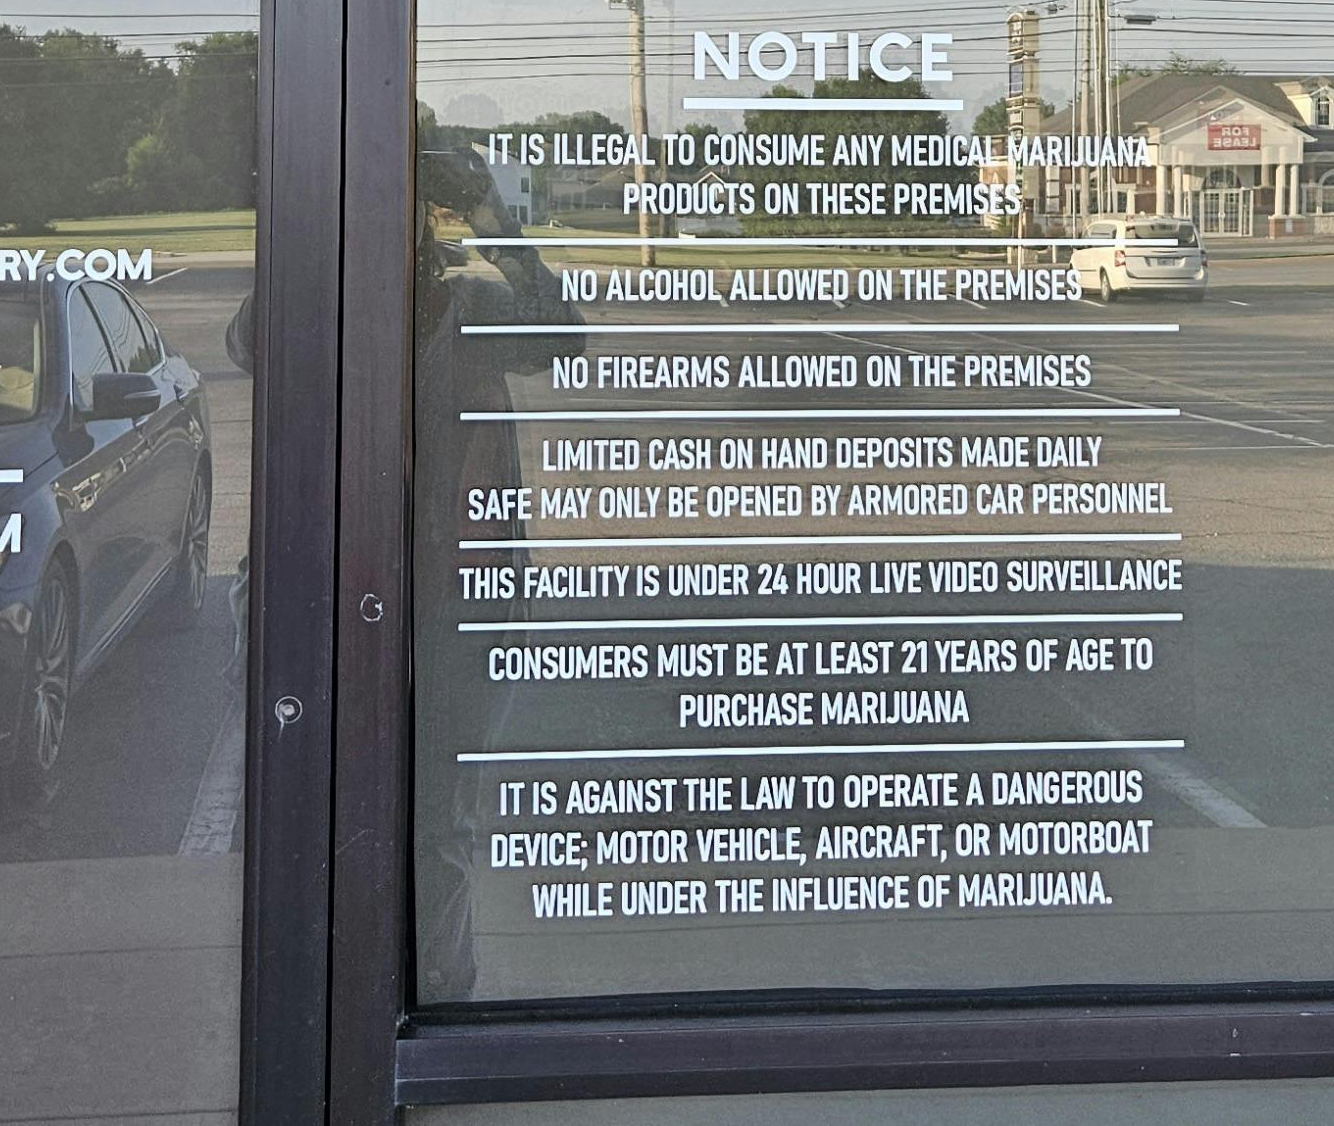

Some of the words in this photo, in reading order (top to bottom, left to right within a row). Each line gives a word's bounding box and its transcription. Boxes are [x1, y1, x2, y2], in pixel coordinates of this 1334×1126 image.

[694, 32, 954, 82] NOTICE
[488, 133, 515, 164] IT
[519, 133, 546, 165] IS
[553, 134, 655, 165] ILLEGAL
[659, 135, 696, 165] TO
[705, 134, 825, 165] CONSUME
[833, 135, 885, 166] ANY
[891, 135, 999, 166] MEDICAL
[1008, 136, 1151, 166] MARIJUANA
[623, 183, 755, 215] PRODUCTS
[764, 183, 799, 215] ON
[806, 183, 886, 215] THESE
[895, 183, 1021, 215] PREMISES
[561, 270, 599, 302] NO
[606, 270, 721, 302] ALCOHOL
[731, 270, 850, 301] ALLOWED
[858, 270, 895, 301] ON
[901, 270, 948, 300] THE
[956, 269, 1082, 300] PREMISES
[553, 356, 589, 389] NO
[598, 356, 729, 388] FIREARMS
[738, 356, 857, 388] ALLOWED
[867, 356, 902, 387] ON
[909, 356, 956, 387] THE
[965, 355, 1092, 386] PREMISES
[542, 438, 640, 472] LIMITED
[648, 438, 711, 471] CASH
[720, 438, 753, 470] ON
[761, 438, 828, 470] HAND
[835, 437, 953, 469] DEPOSITS
[961, 436, 1029, 468] MADE
[1036, 436, 1103, 468] DAILY
[468, 488, 532, 520] SAFE
[540, 487, 595, 520] MAY
[598, 486, 661, 519] ONLY
[668, 486, 699, 518] BE
[706, 485, 803, 518] OPENED
[810, 485, 846, 517] BY
[848, 485, 968, 517] ARMORED
[976, 483, 1025, 515] CAR
[1032, 483, 1173, 516] PERSONNEL
[459, 567, 515, 601] THIS
[523, 566, 631, 600] FACILITY
[635, 565, 659, 598] IS
[668, 564, 749, 598] UNDER
[757, 564, 788, 596] 24
[796, 563, 863, 595] HOUR
[869, 562, 922, 594] LIVE
[928, 561, 998, 593] VIDEO
[1006, 559, 1183, 593] SURVEILLANCE
[488, 645, 648, 681] CONSUMERS
[657, 643, 728, 678] MUST
[736, 643, 768, 676] BE
[775, 642, 809, 675] AT
[815, 641, 894, 675] LEAST
[901, 640, 929, 673] 21
[935, 640, 1017, 673] YEARS
[1026, 638, 1059, 671] OF
[1065, 638, 1115, 671] AGE
[1120, 637, 1153, 670] TO
[679, 693, 814, 728] PURCHASE
[821, 690, 969, 725] MARIJUANA
[499, 782, 525, 816] IT
[531, 782, 557, 816] IS
[565, 779, 677, 814] AGAINST
[684, 778, 733, 812] THE
[739, 776, 796, 811] LAW
[801, 775, 835, 810] TO
[843, 773, 959, 809] OPERATE
[963, 772, 985, 806] A
[992, 770, 1143, 805] DANGEROUS
[491, 832, 589, 868] DEVICE;
[596, 830, 689, 865] MOTOR
[696, 826, 809, 865] VEHICLE,
[815, 824, 948, 860] AIRCRAFT,
[955, 823, 990, 856] OR
[998, 820, 1153, 855] MOTORBOAT
[532, 883, 614, 918] WHILE
[621, 881, 708, 916] UNDER
[715, 879, 765, 912] THE
[771, 876, 910, 912] INFLUENCE
[918, 875, 951, 909] OF
[958, 872, 1112, 907] MARIJUANA.
